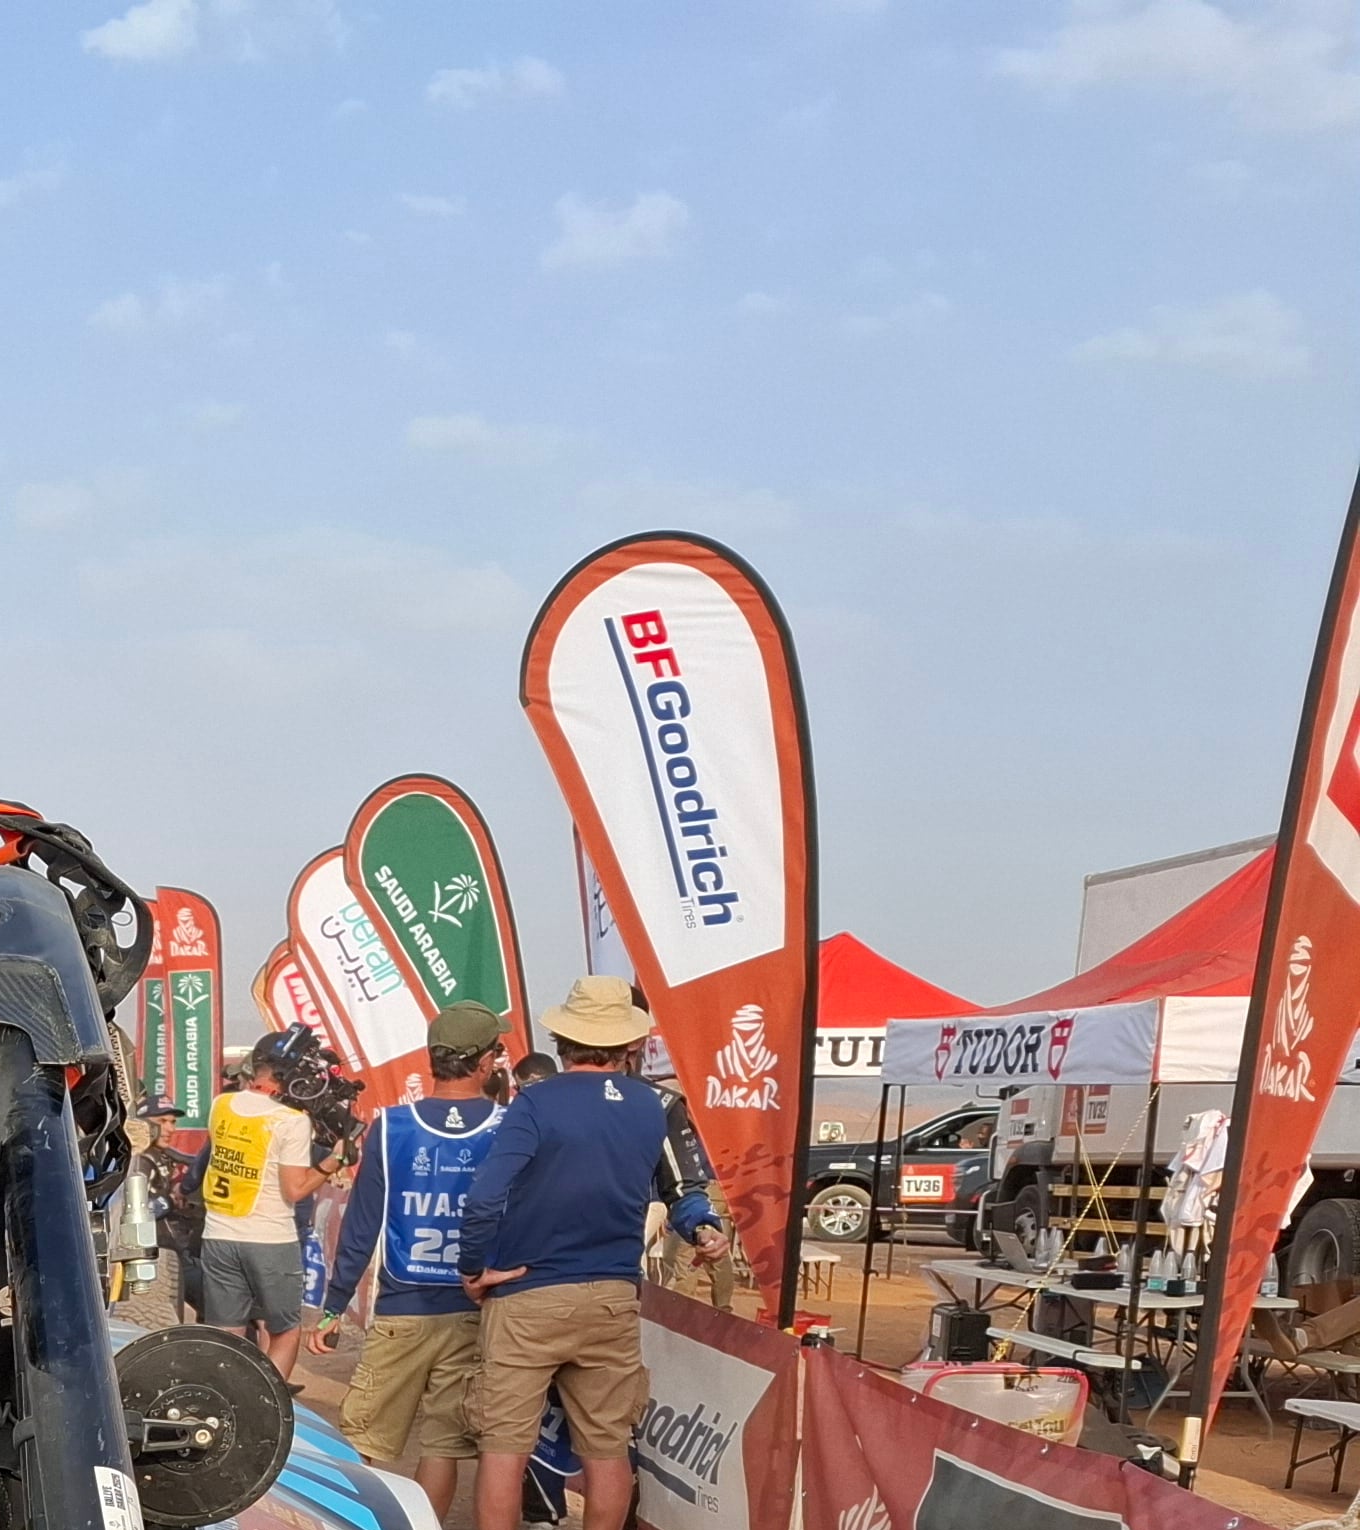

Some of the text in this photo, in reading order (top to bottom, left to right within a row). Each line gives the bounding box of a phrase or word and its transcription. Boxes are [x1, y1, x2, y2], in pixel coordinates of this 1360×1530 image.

[620, 608, 739, 929] BFGoodrich
[168, 941, 209, 957] DAKAR
[373, 864, 458, 998] SAUDI ARABIA
[185, 1016, 200, 1119] SAUDI ARABIA
[953, 1025, 1046, 1075] TUDOR
[704, 1073, 781, 1112] DAKAR
[1258, 1050, 1316, 1102] DAKAR
[212, 1175, 231, 1200] 5
[401, 1190, 432, 1217] TV
[904, 1179, 941, 1192] TV36
